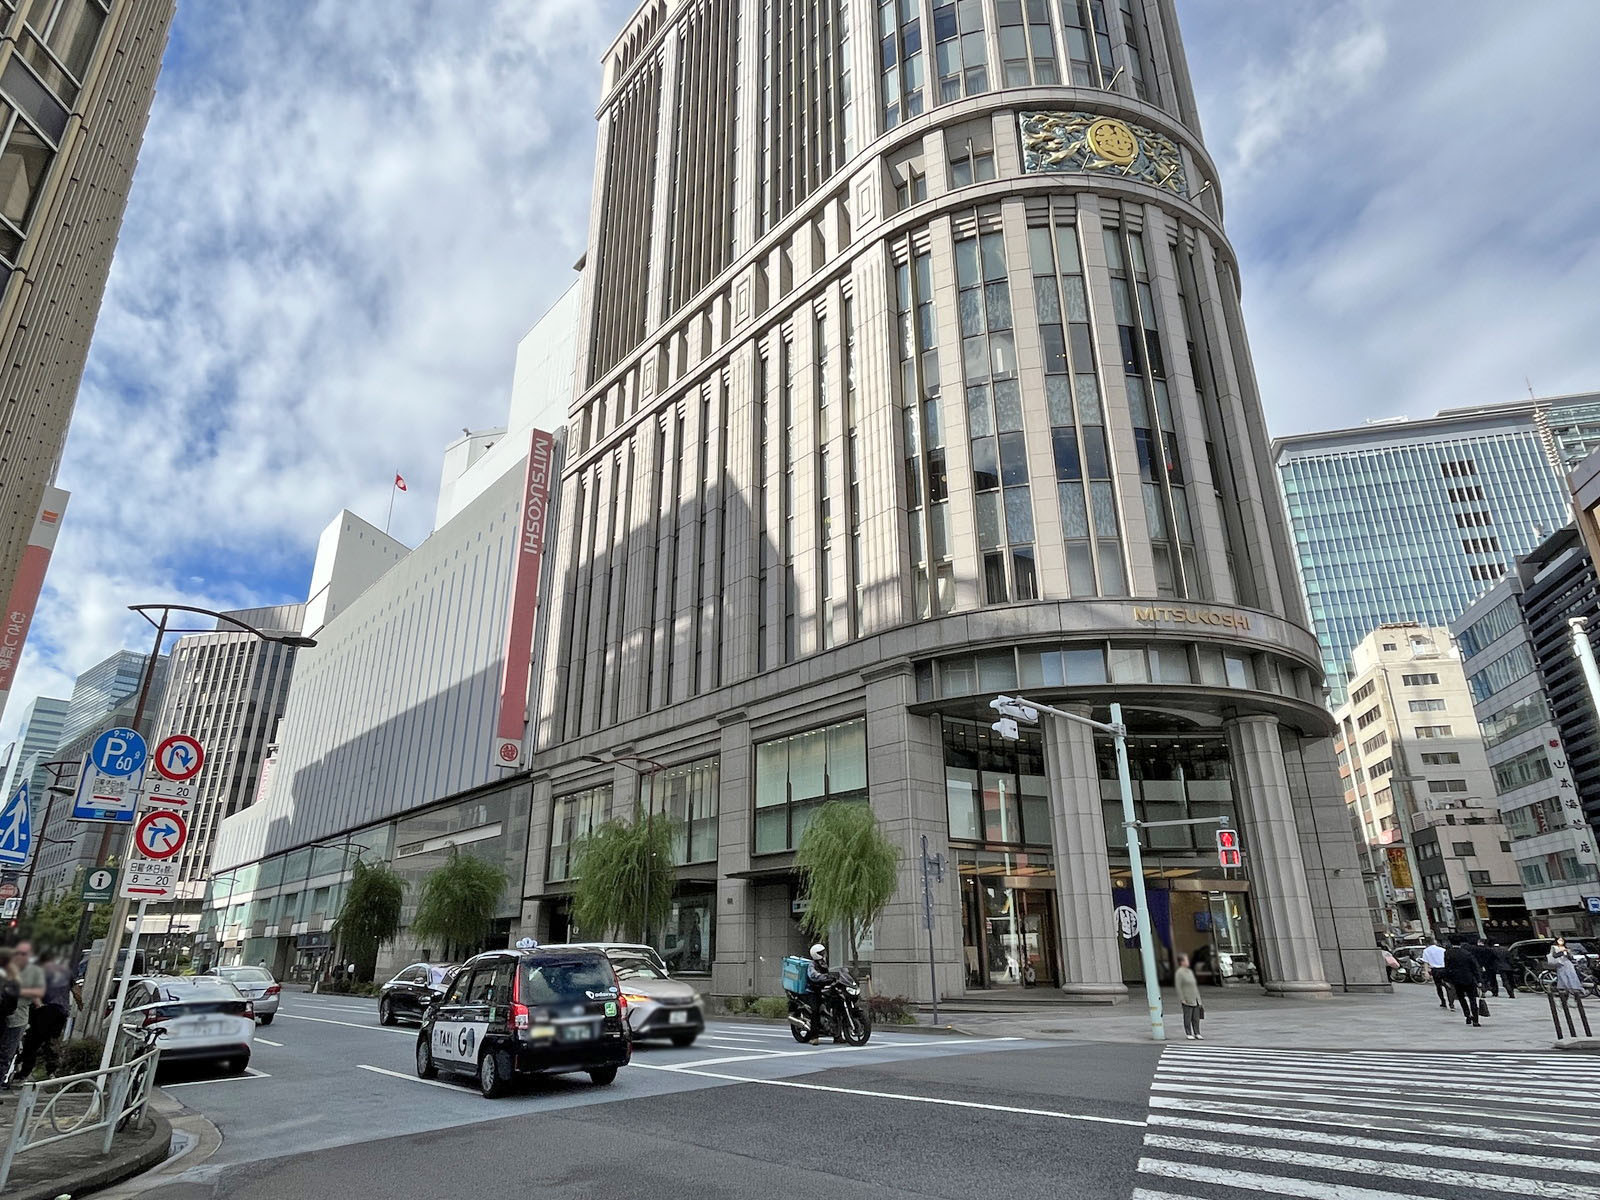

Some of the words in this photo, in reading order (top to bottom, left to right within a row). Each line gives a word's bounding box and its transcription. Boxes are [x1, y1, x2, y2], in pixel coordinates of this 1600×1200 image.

[523, 438, 549, 554] MITSUKOSHI
[1133, 607, 1251, 630] MITSUKOSHI
[114, 730, 135, 740] 9-19
[116, 756, 132, 771] 60
